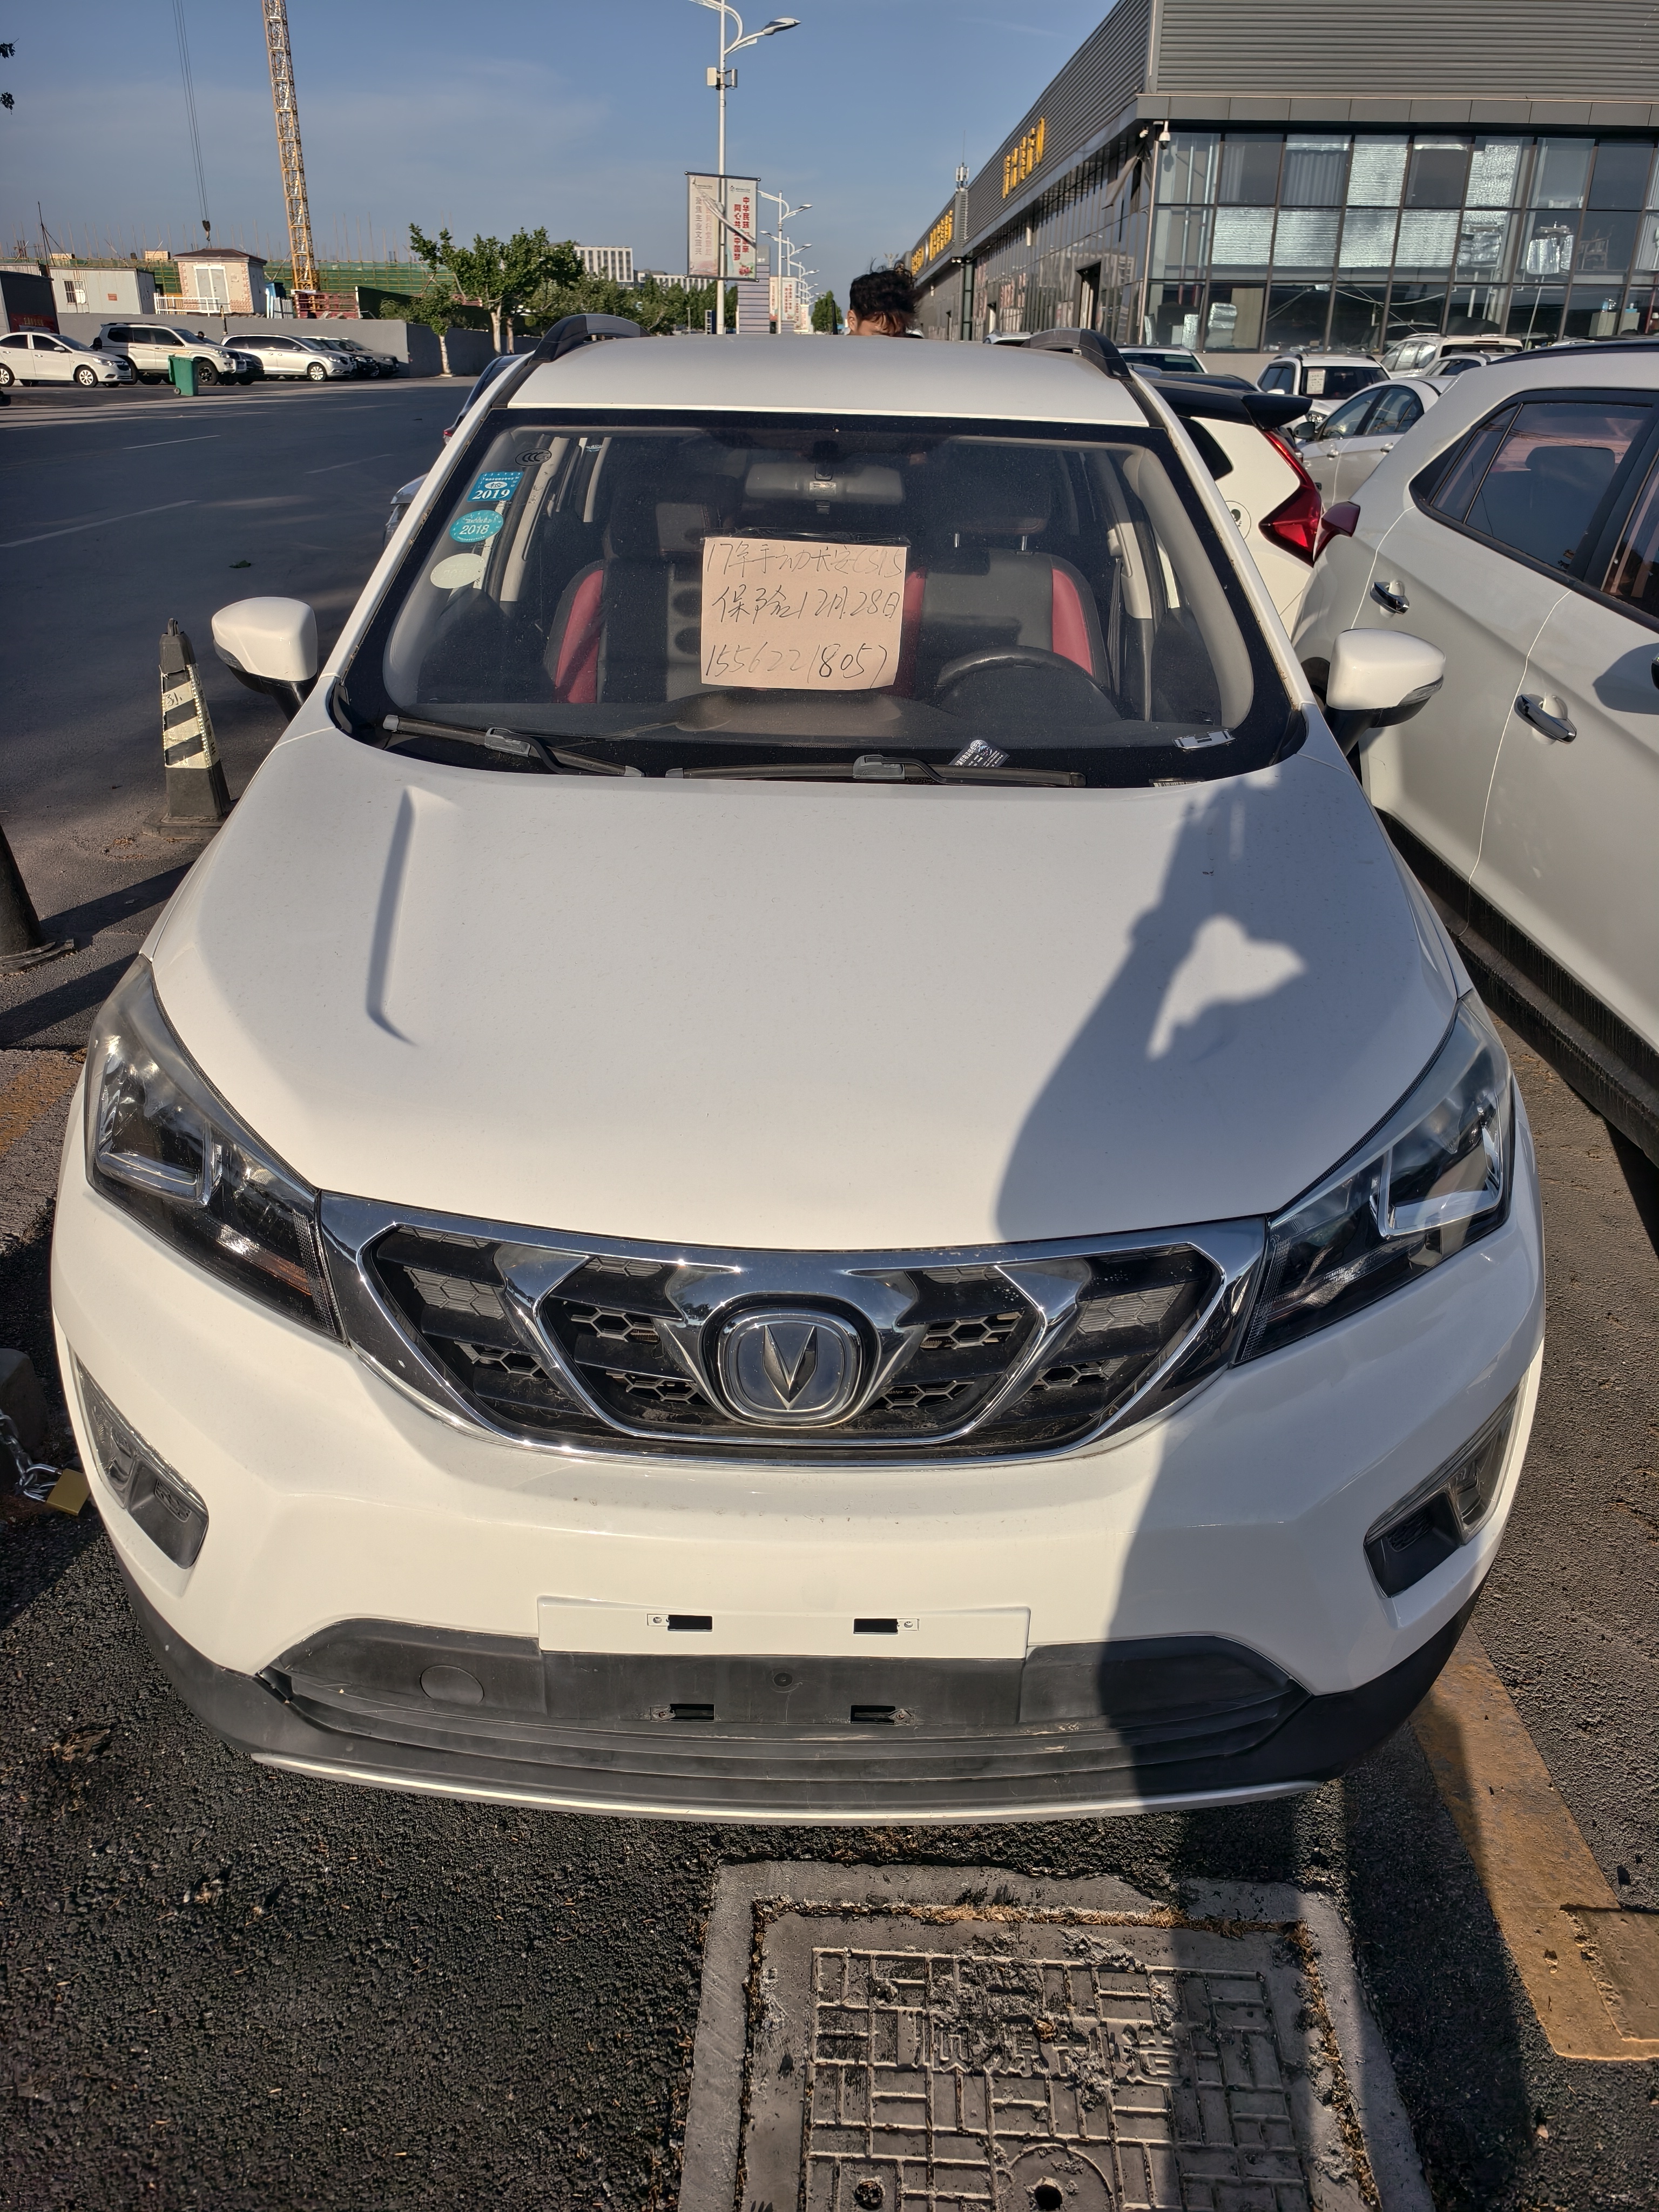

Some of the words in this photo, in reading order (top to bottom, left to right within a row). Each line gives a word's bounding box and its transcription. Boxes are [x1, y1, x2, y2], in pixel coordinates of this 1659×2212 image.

[733, 204, 741, 261] 同心共中国梦
[741, 197, 750, 253] 中华民族
[472, 489, 510, 500] 2019
[459, 524, 490, 535] 2018
[705, 642, 887, 689] 15562218057
